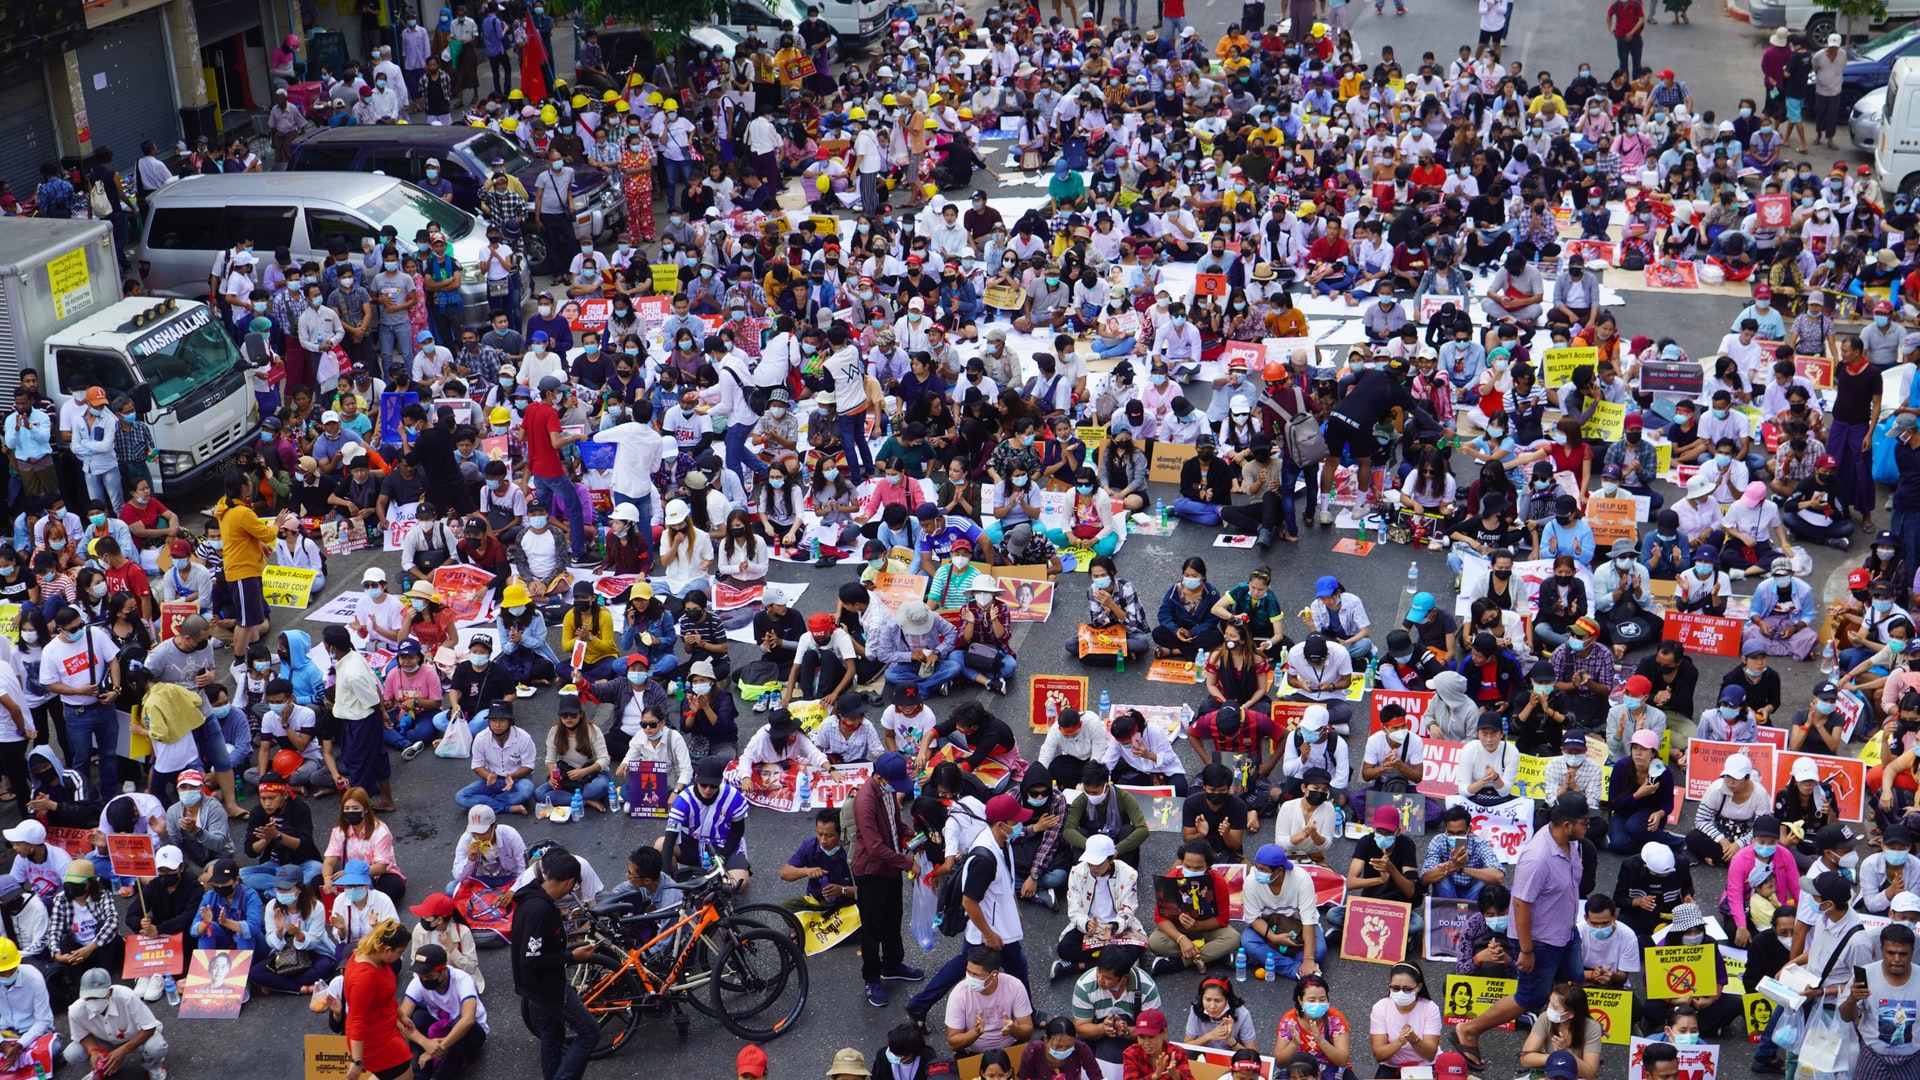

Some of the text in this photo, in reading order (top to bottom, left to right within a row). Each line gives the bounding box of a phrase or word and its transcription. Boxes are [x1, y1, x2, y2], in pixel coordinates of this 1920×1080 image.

[138, 310, 210, 357] MASHAALLAH
[1557, 352, 1572, 360] Don't
[1574, 351, 1595, 360] Accept
[1548, 364, 1577, 372] MILITARY
[1600, 406, 1622, 416] Accept
[1602, 418, 1620, 426] COUP
[1597, 502, 1628, 511] HELP US
[292, 572, 313, 580] Accept
[106, 576, 129, 592] USA
[263, 580, 308, 591] MILITARY COUP
[1693, 631, 1723, 640] PEOPLE'S
[1693, 747, 1709, 755] OUR
[1519, 756, 1537, 765] Don't
[1422, 761, 1460, 785] DM
[50, 827, 85, 839] HELP US
[1365, 908, 1405, 918] DISOBEDIENCE
[1863, 920, 1891, 928] MILITA
[1665, 948, 1681, 956] DON'T
[1682, 947, 1704, 955] ACCEPT
[672, 939, 697, 976] GIANT
[1660, 956, 1685, 964] MILITARY
[1604, 1000, 1619, 1008] COUP
